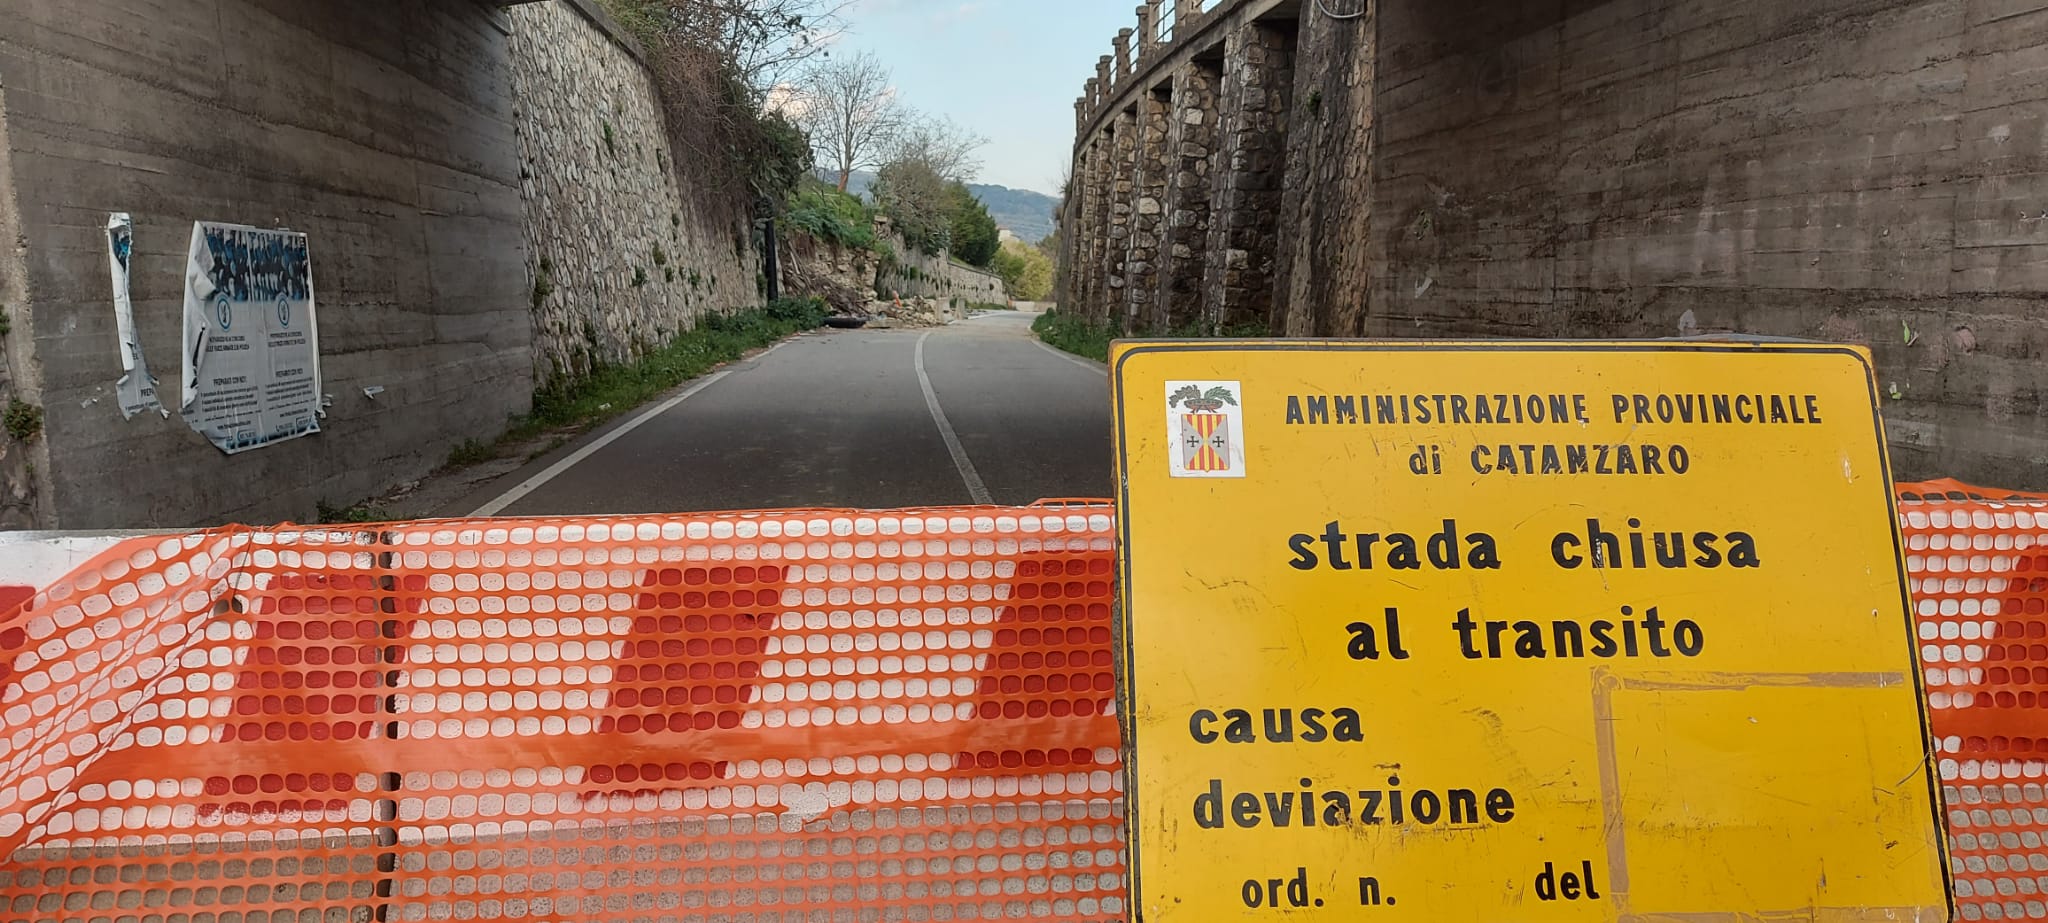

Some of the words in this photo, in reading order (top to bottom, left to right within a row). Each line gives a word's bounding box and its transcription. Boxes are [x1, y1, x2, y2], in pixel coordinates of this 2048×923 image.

[1285, 394, 1590, 425] AMMINISTRAZIONE
[1611, 394, 1822, 424] PROVINCIALE
[1408, 445, 1441, 475] di
[1470, 444, 1690, 475] CATANZARO
[1288, 518, 1502, 571] strada
[1550, 517, 1761, 569] chiusa
[1345, 607, 1410, 660] al
[1451, 605, 1705, 660] transito
[1188, 707, 1365, 745] causa
[1193, 776, 1516, 829] deviazione
[1241, 867, 1324, 909] ord.
[1358, 875, 1397, 906] n.
[1534, 860, 1601, 902] del
